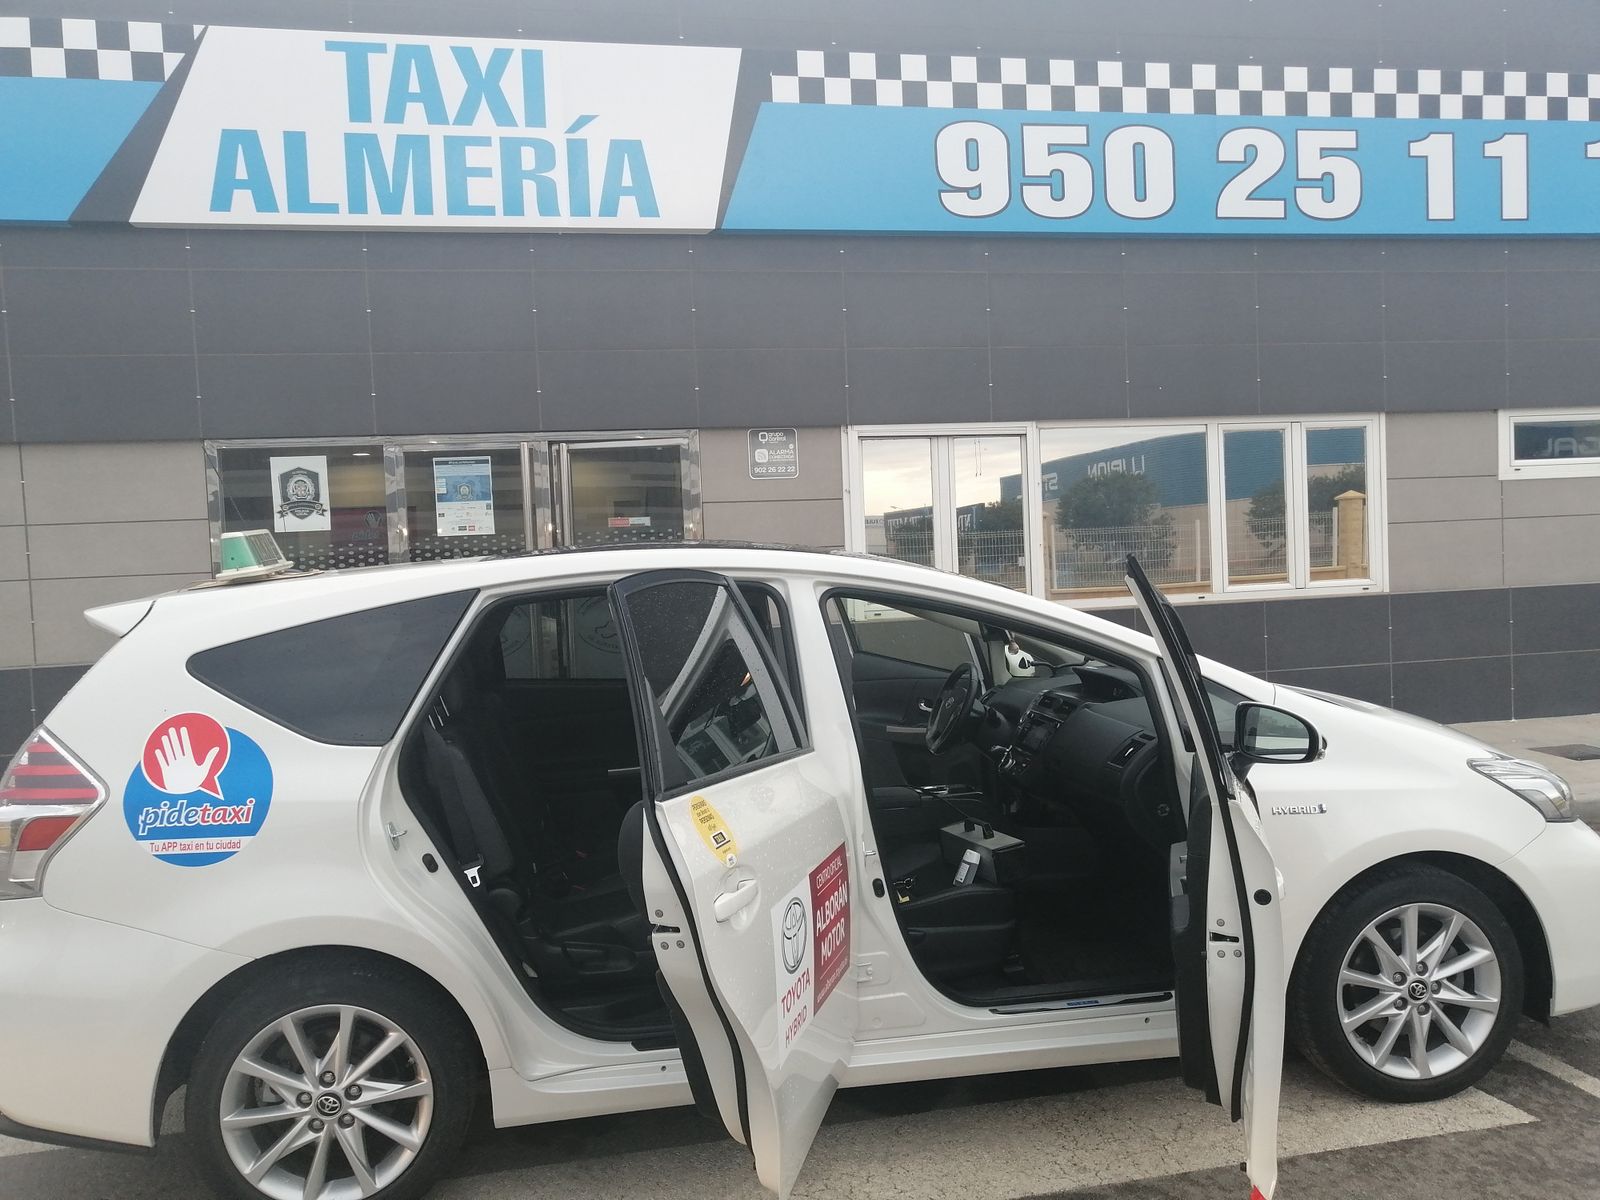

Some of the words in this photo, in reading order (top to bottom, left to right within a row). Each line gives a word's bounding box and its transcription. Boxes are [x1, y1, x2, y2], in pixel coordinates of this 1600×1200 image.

[324, 40, 547, 129] TAXI
[209, 114, 661, 219] ALMERÍA
[934, 119, 1177, 220] 950
[1215, 127, 1363, 221] 25
[1408, 131, 1531, 221] 11
[138, 798, 256, 835] pidetaxi
[1272, 805, 1318, 815] HYBRID
[150, 842, 160, 852] Tu
[161, 841, 178, 852] APP
[179, 841, 194, 851] taxi
[195, 842, 204, 851] en
[206, 841, 215, 850] tu
[215, 839, 241, 850] ciudad
[816, 878, 848, 936] ALBORÁN
[821, 923, 846, 966] MOTOR
[781, 967, 811, 1019] TOYOTA
[785, 1004, 808, 1048] HYBRID
